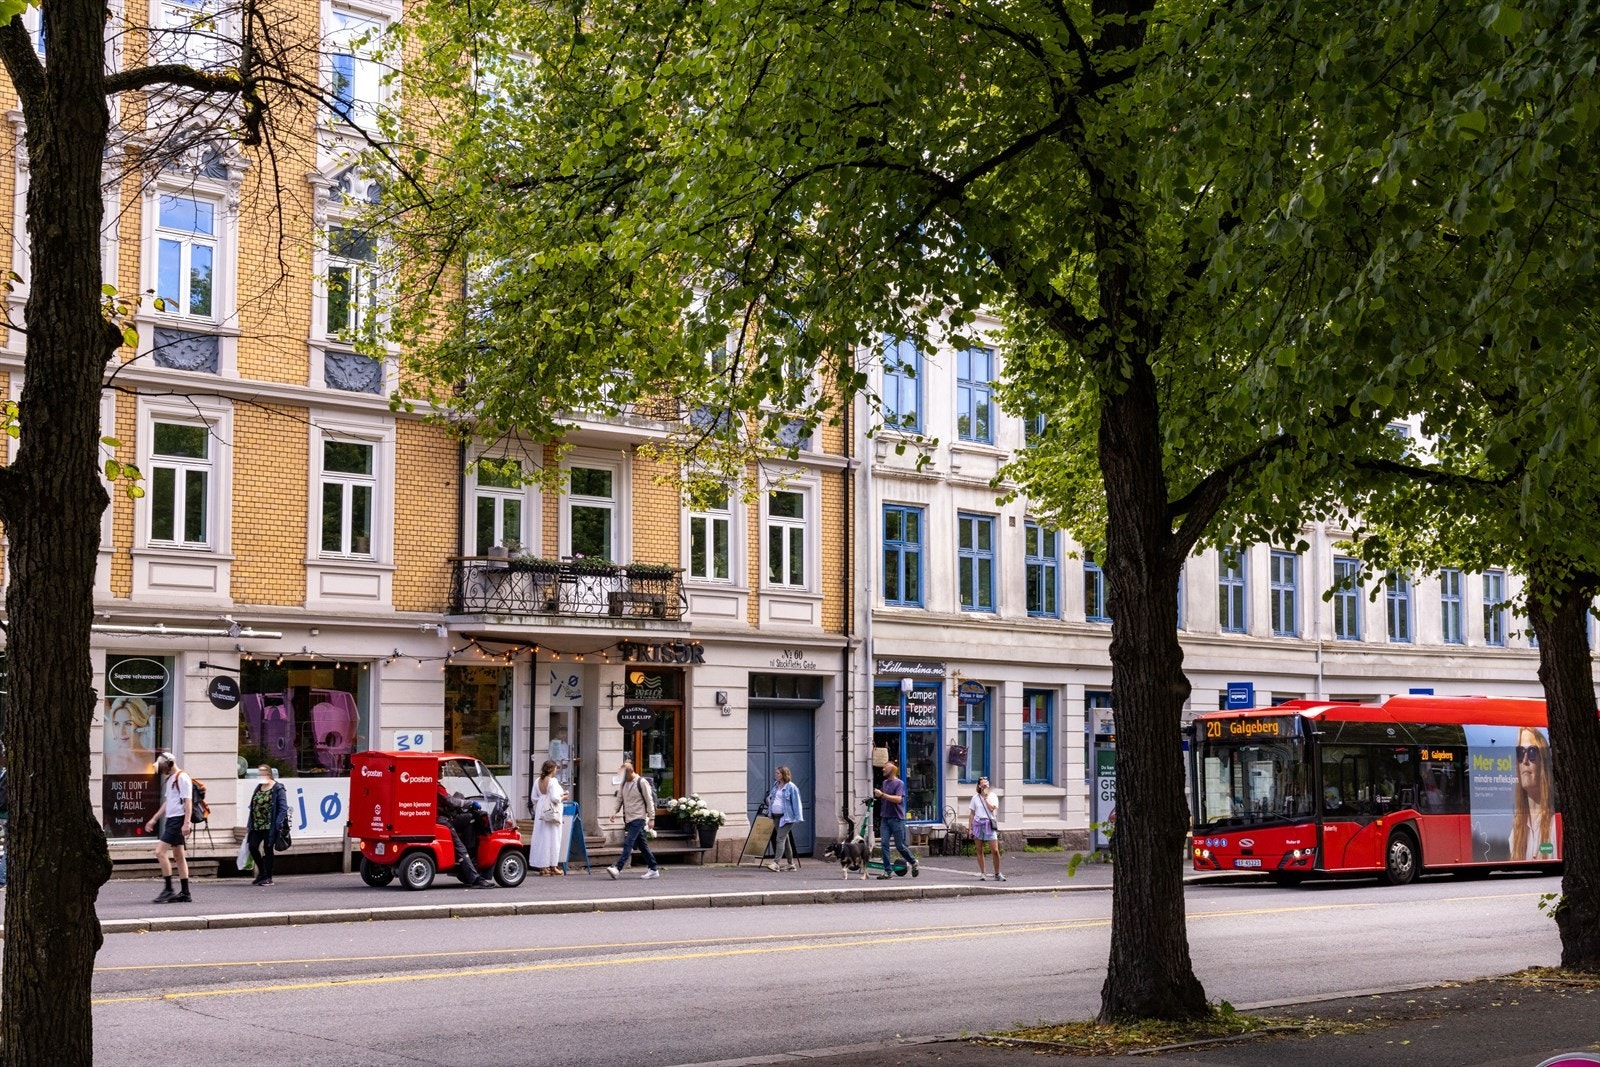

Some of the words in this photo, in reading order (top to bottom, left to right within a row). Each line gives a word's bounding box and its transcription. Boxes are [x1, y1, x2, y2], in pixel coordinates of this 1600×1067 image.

[794, 650, 803, 660] 60
[803, 661, 816, 669] Gade
[881, 660, 944, 674] Lillemedina.no
[908, 691, 937, 702] Lamper
[875, 705, 900, 716] Puffer
[908, 702, 937, 716] Tepper
[908, 716, 937, 726] Mosaikk
[1207, 721, 1221, 738] 20
[1230, 720, 1279, 736] Galgeberg
[1421, 749, 1429, 760] 20
[1431, 749, 1453, 761] Galgeberg
[1473, 754, 1494, 771] Mer
[1497, 754, 1512, 771] sol
[367, 770, 383, 778] posten
[409, 776, 433, 784] posten
[1473, 774, 1492, 783] mindre
[1493, 774, 1519, 785] refleksjon
[111, 781, 127, 790] JUST
[129, 781, 148, 790] DON'T
[116, 791, 134, 800] CALL
[135, 791, 142, 800] IT
[113, 801, 118, 810] A
[120, 801, 146, 810] FACIAL.
